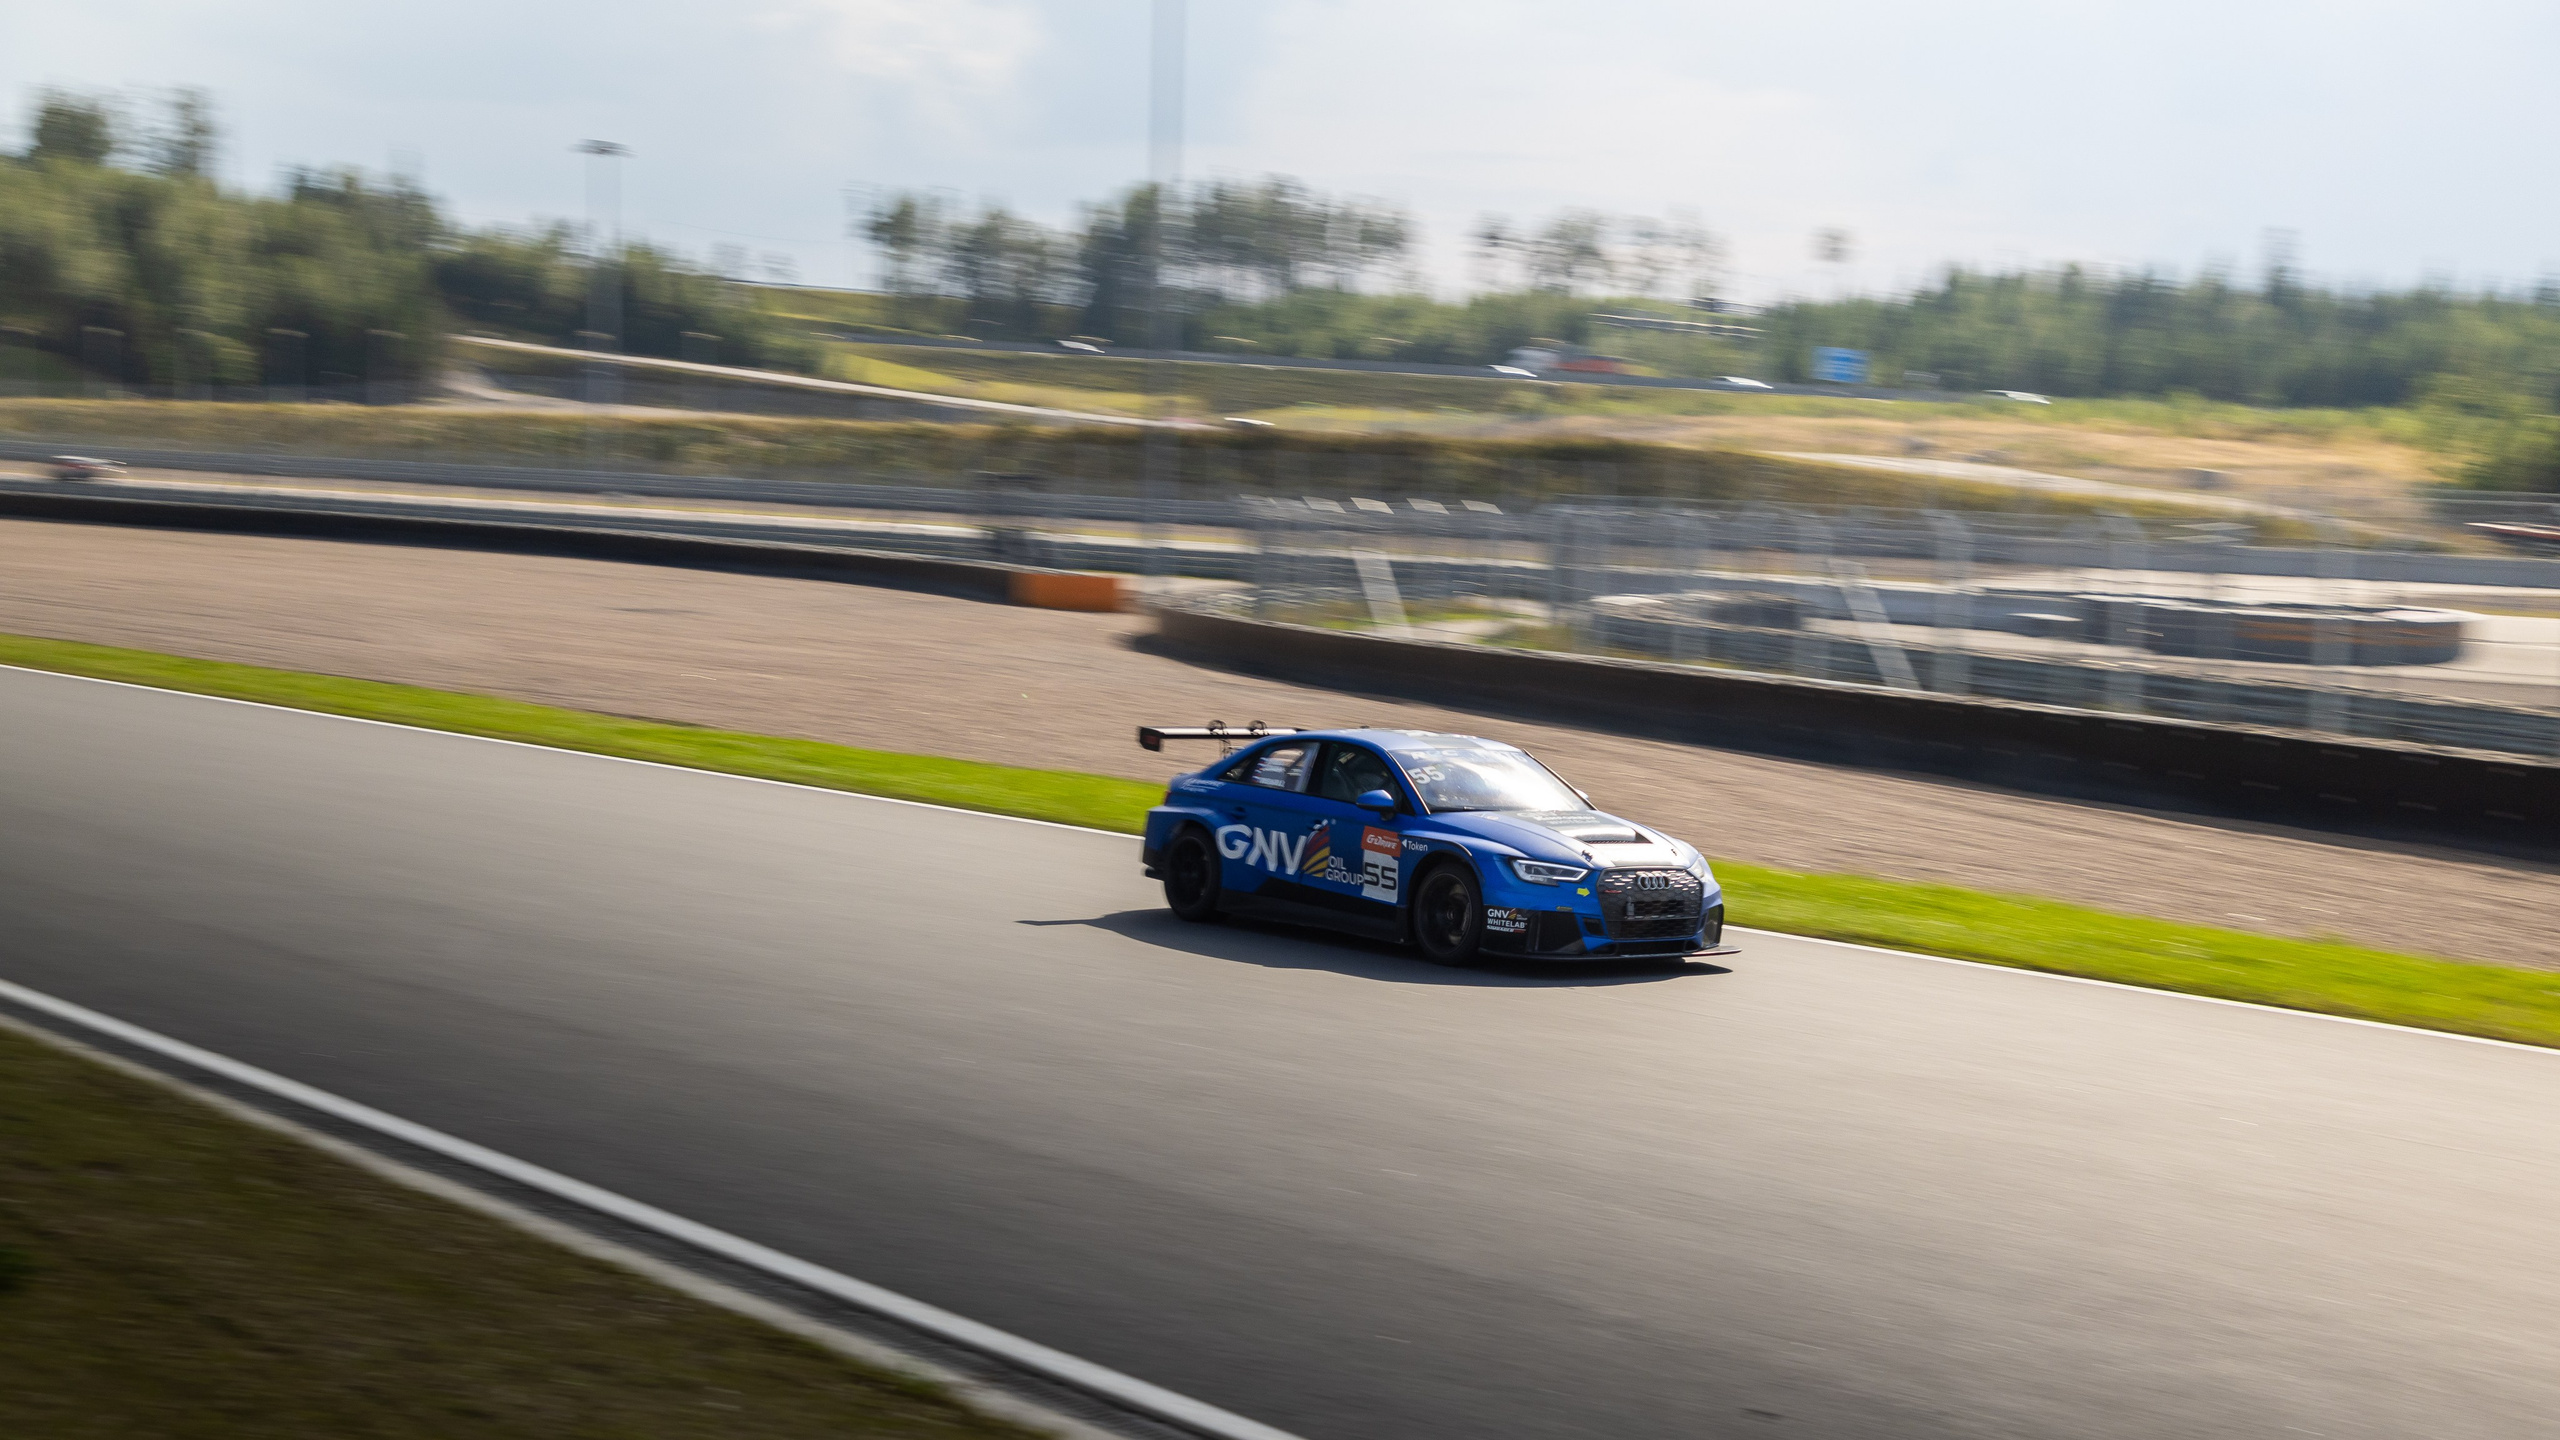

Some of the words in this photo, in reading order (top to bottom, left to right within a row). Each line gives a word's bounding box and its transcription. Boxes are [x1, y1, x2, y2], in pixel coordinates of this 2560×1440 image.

[1407, 766, 1446, 785] 55
[1215, 824, 1308, 876] GNV
[1408, 840, 1428, 852] Token
[1328, 855, 1346, 870] OIL
[1325, 868, 1365, 886] GROUP
[1364, 862, 1397, 890] 55
[1487, 908, 1510, 919] GNV
[1487, 917, 1525, 929] WHITELAB
